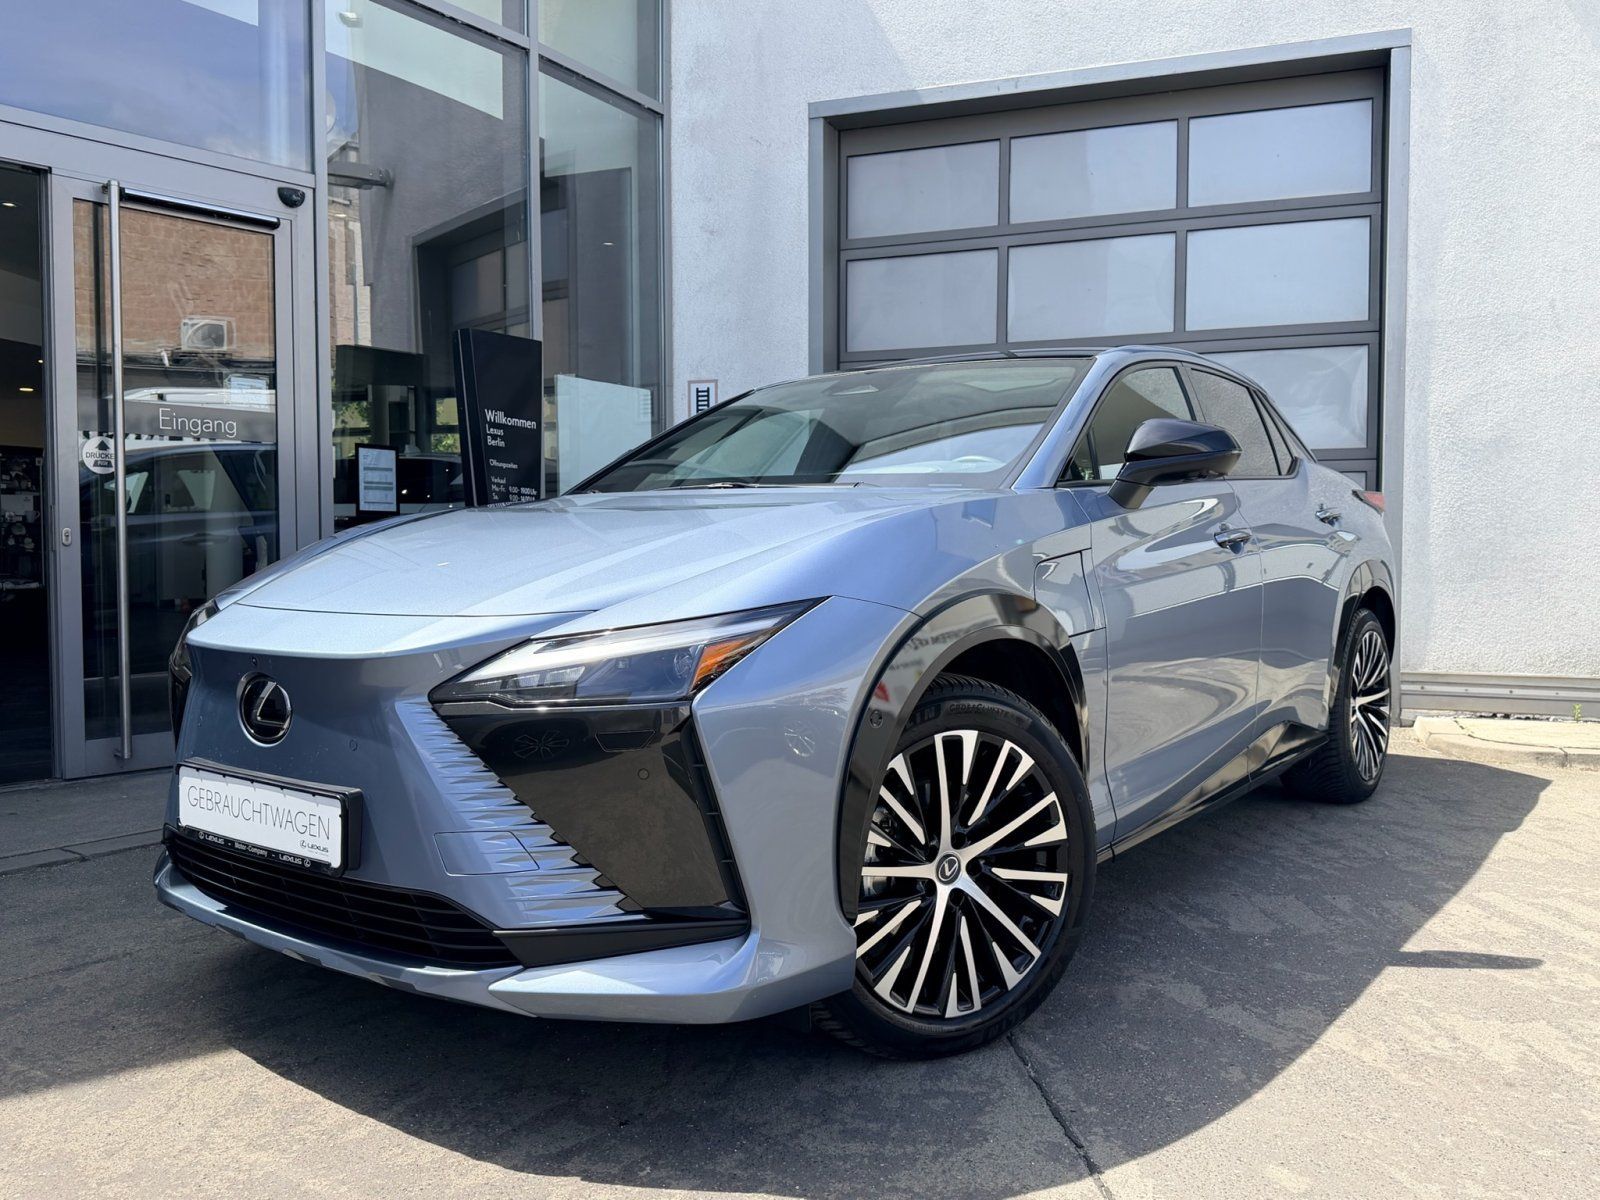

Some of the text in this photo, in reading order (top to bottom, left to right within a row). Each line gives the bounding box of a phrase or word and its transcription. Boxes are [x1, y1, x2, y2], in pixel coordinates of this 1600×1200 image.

[159, 407, 237, 438] Eingang
[485, 409, 537, 430] Willkommen
[486, 423, 504, 436] Lexus
[487, 435, 506, 448] Berlin
[85, 450, 116, 460] DRÜCKE
[187, 785, 330, 841] GEBRAUCHTWAGEN
[205, 834, 225, 845] LEXUS
[279, 854, 302, 865] LEXUS
[307, 843, 329, 853] LEXUS
